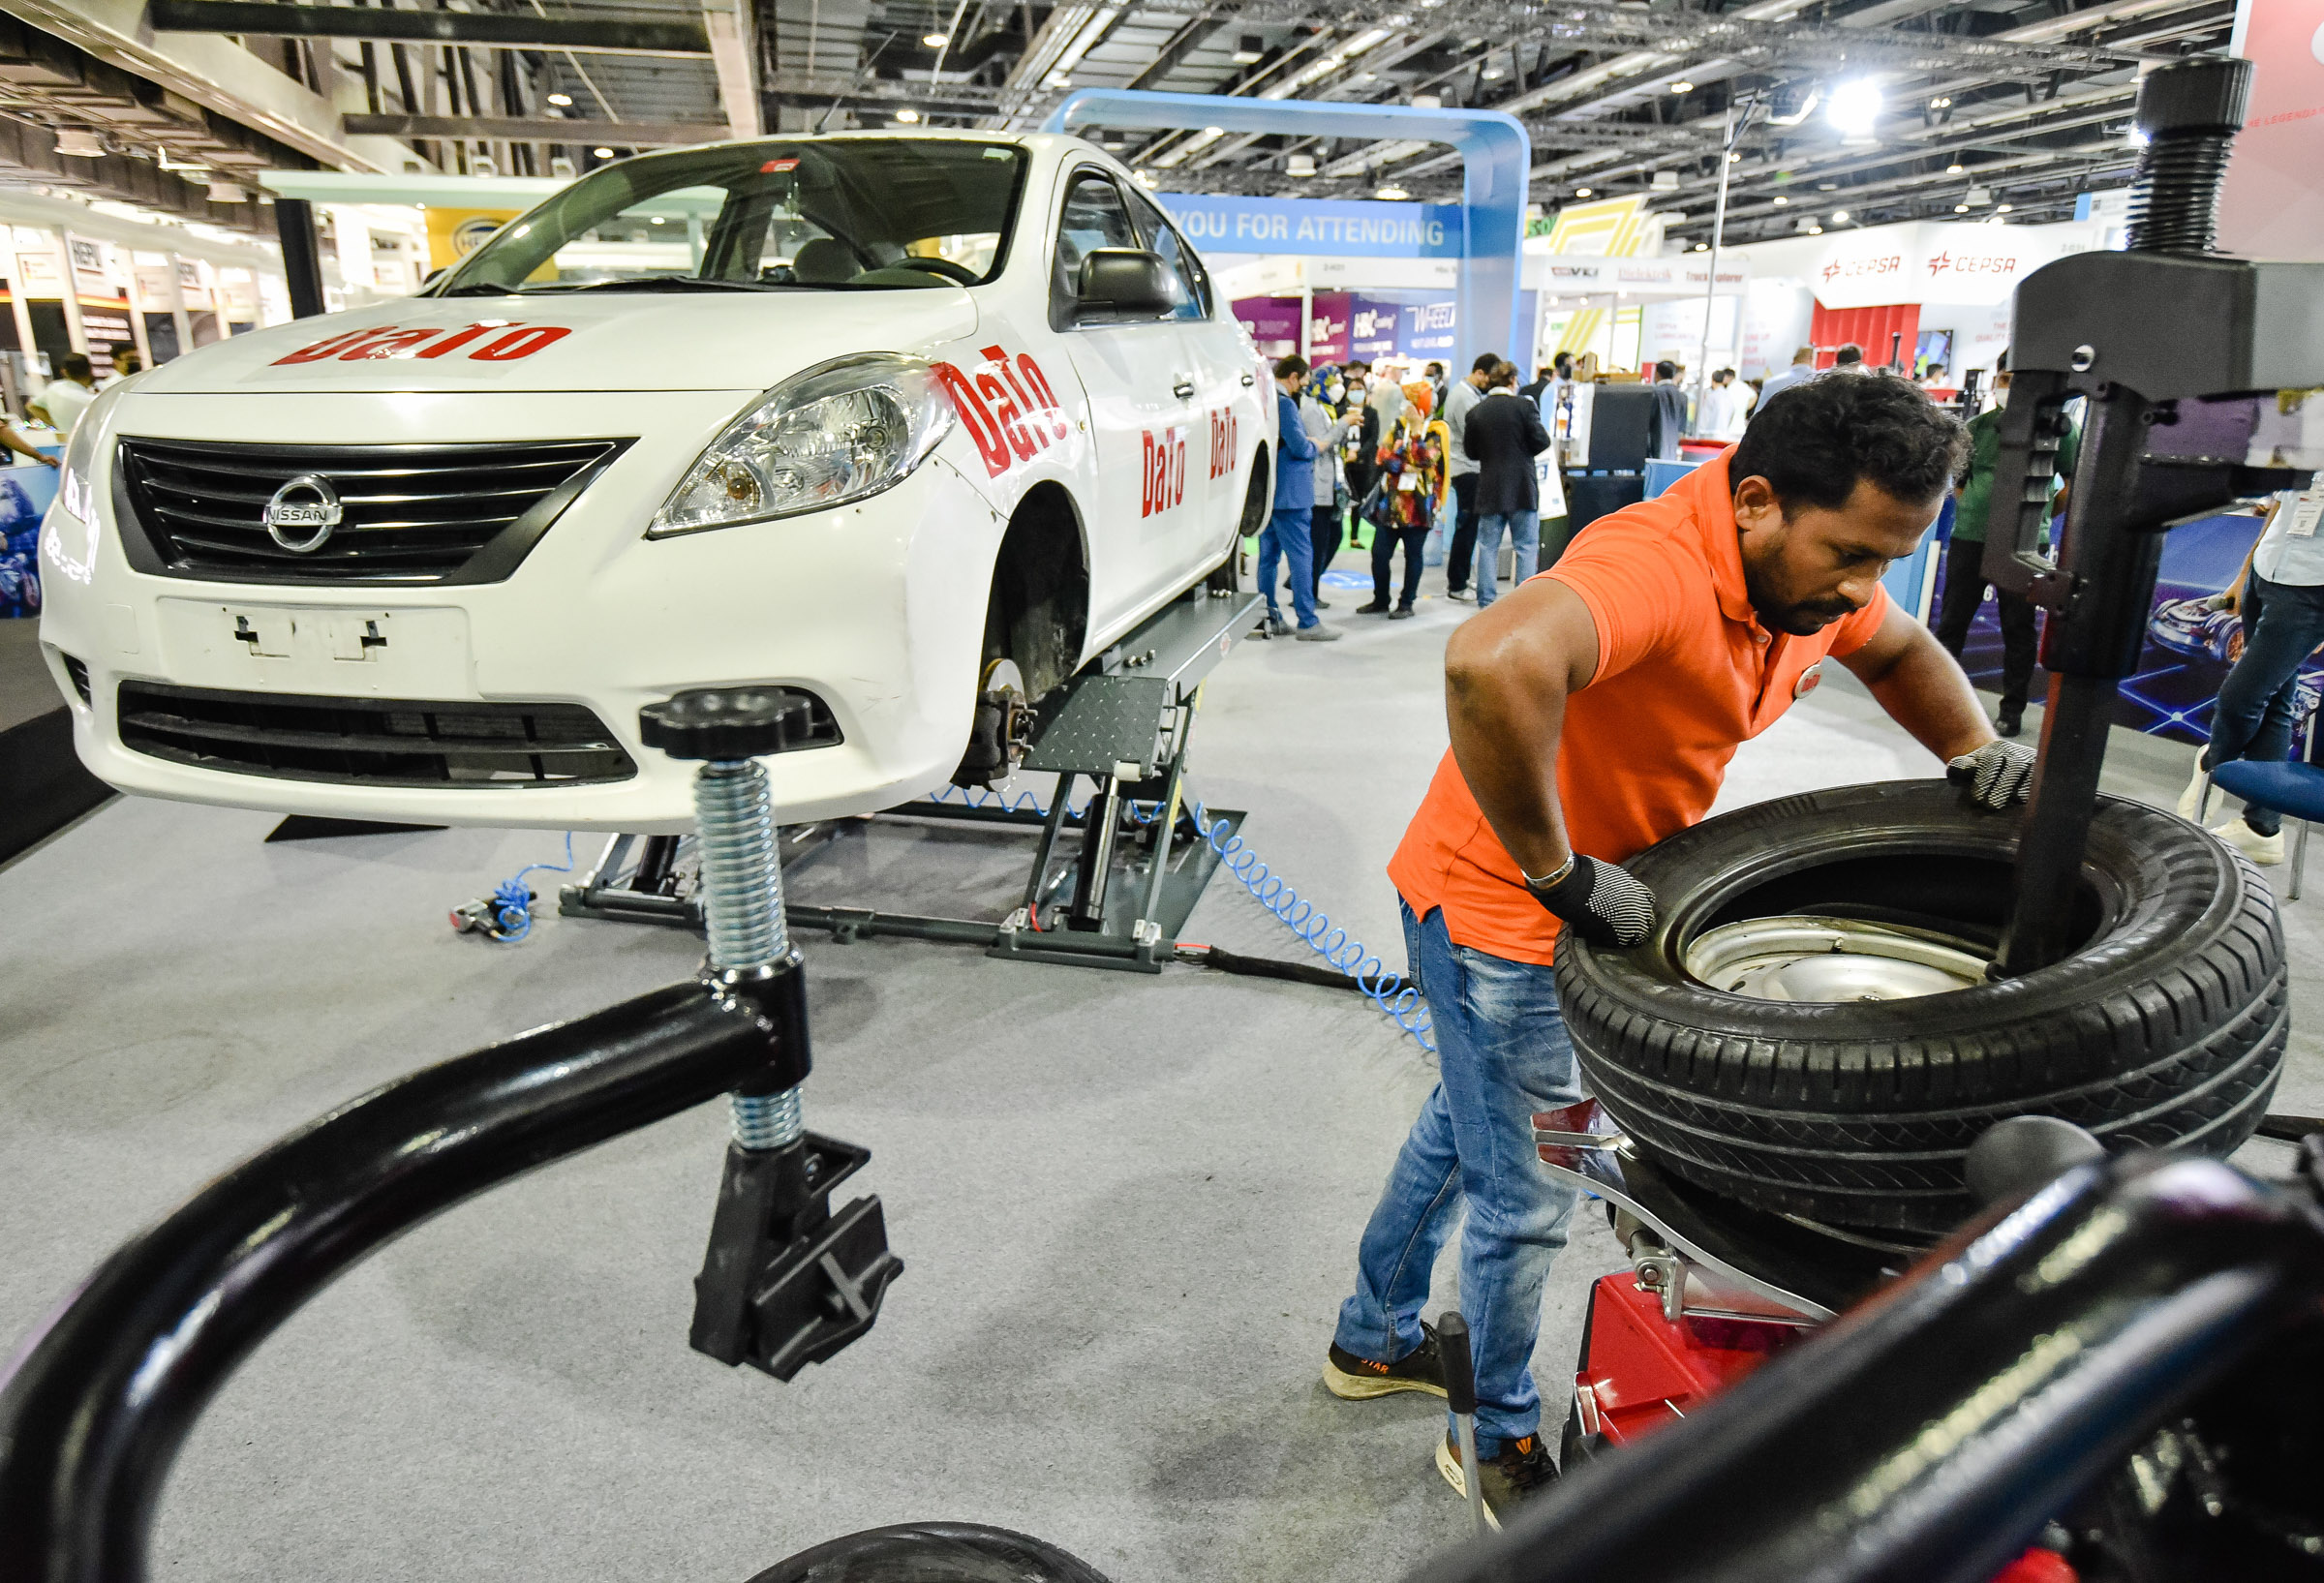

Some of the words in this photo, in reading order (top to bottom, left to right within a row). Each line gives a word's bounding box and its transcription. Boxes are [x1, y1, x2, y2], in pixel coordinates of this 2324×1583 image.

[1173, 210, 1227, 239] YOU
[1237, 213, 1289, 240] FOR
[1296, 216, 1445, 247] ATTENDING
[1845, 256, 1901, 277] CEPSA
[1955, 257, 2016, 274] CEPSA
[270, 509, 327, 522] NISSAN
